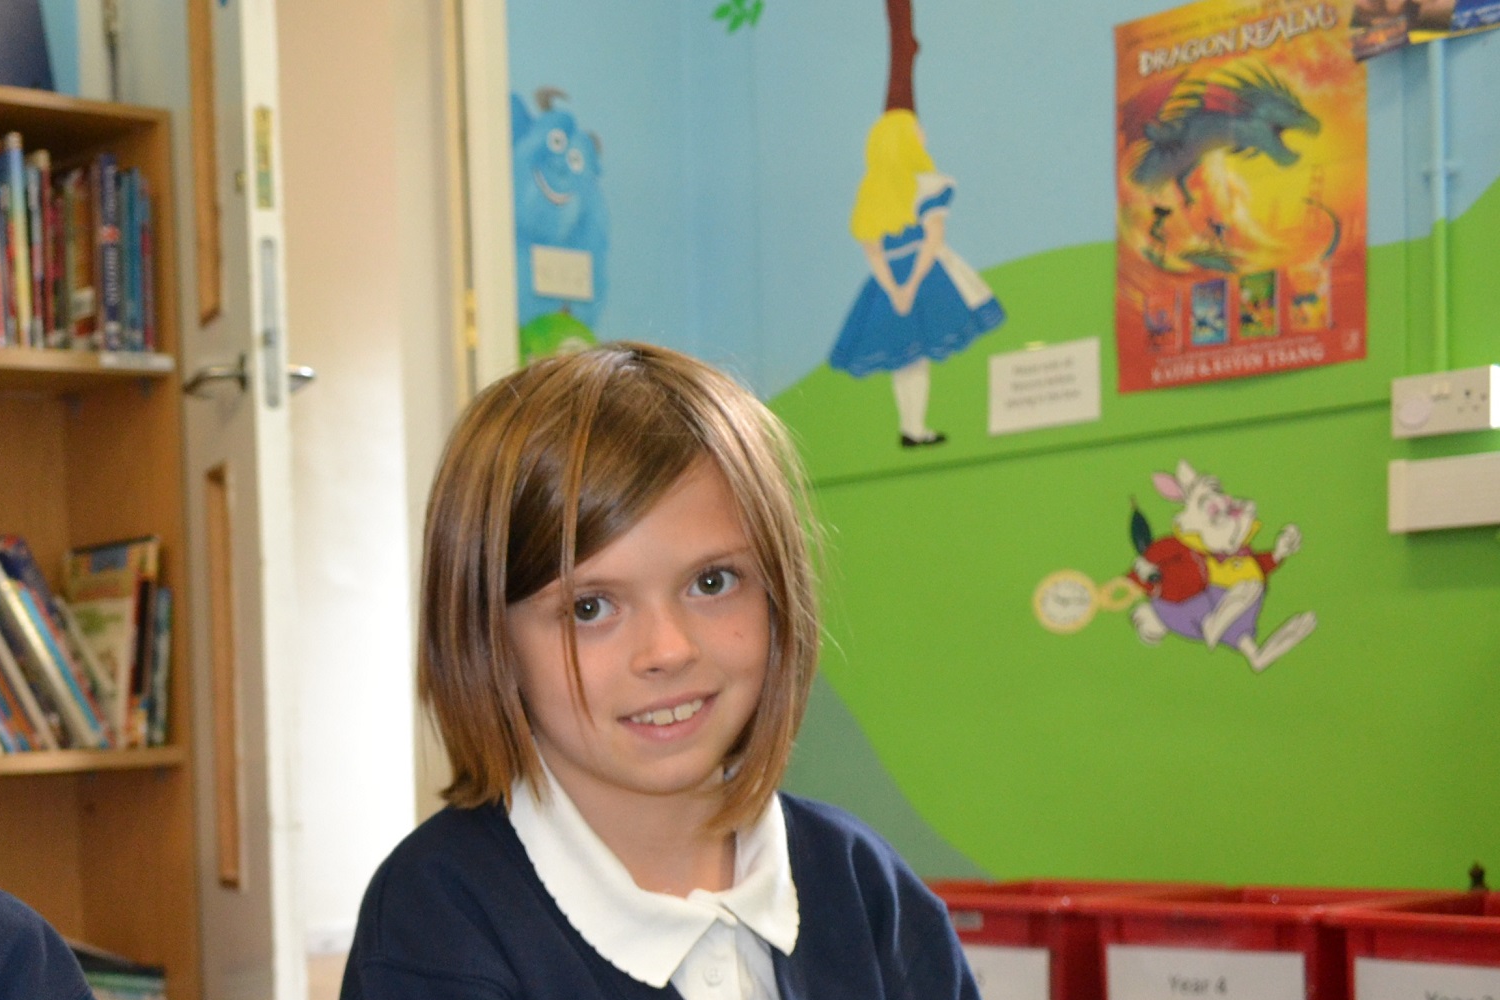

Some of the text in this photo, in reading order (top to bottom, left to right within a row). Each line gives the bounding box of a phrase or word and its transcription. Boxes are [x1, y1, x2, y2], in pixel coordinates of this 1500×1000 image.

[1138, 28, 1238, 77] DRAGON
[1167, 974, 1228, 995] Year 4
